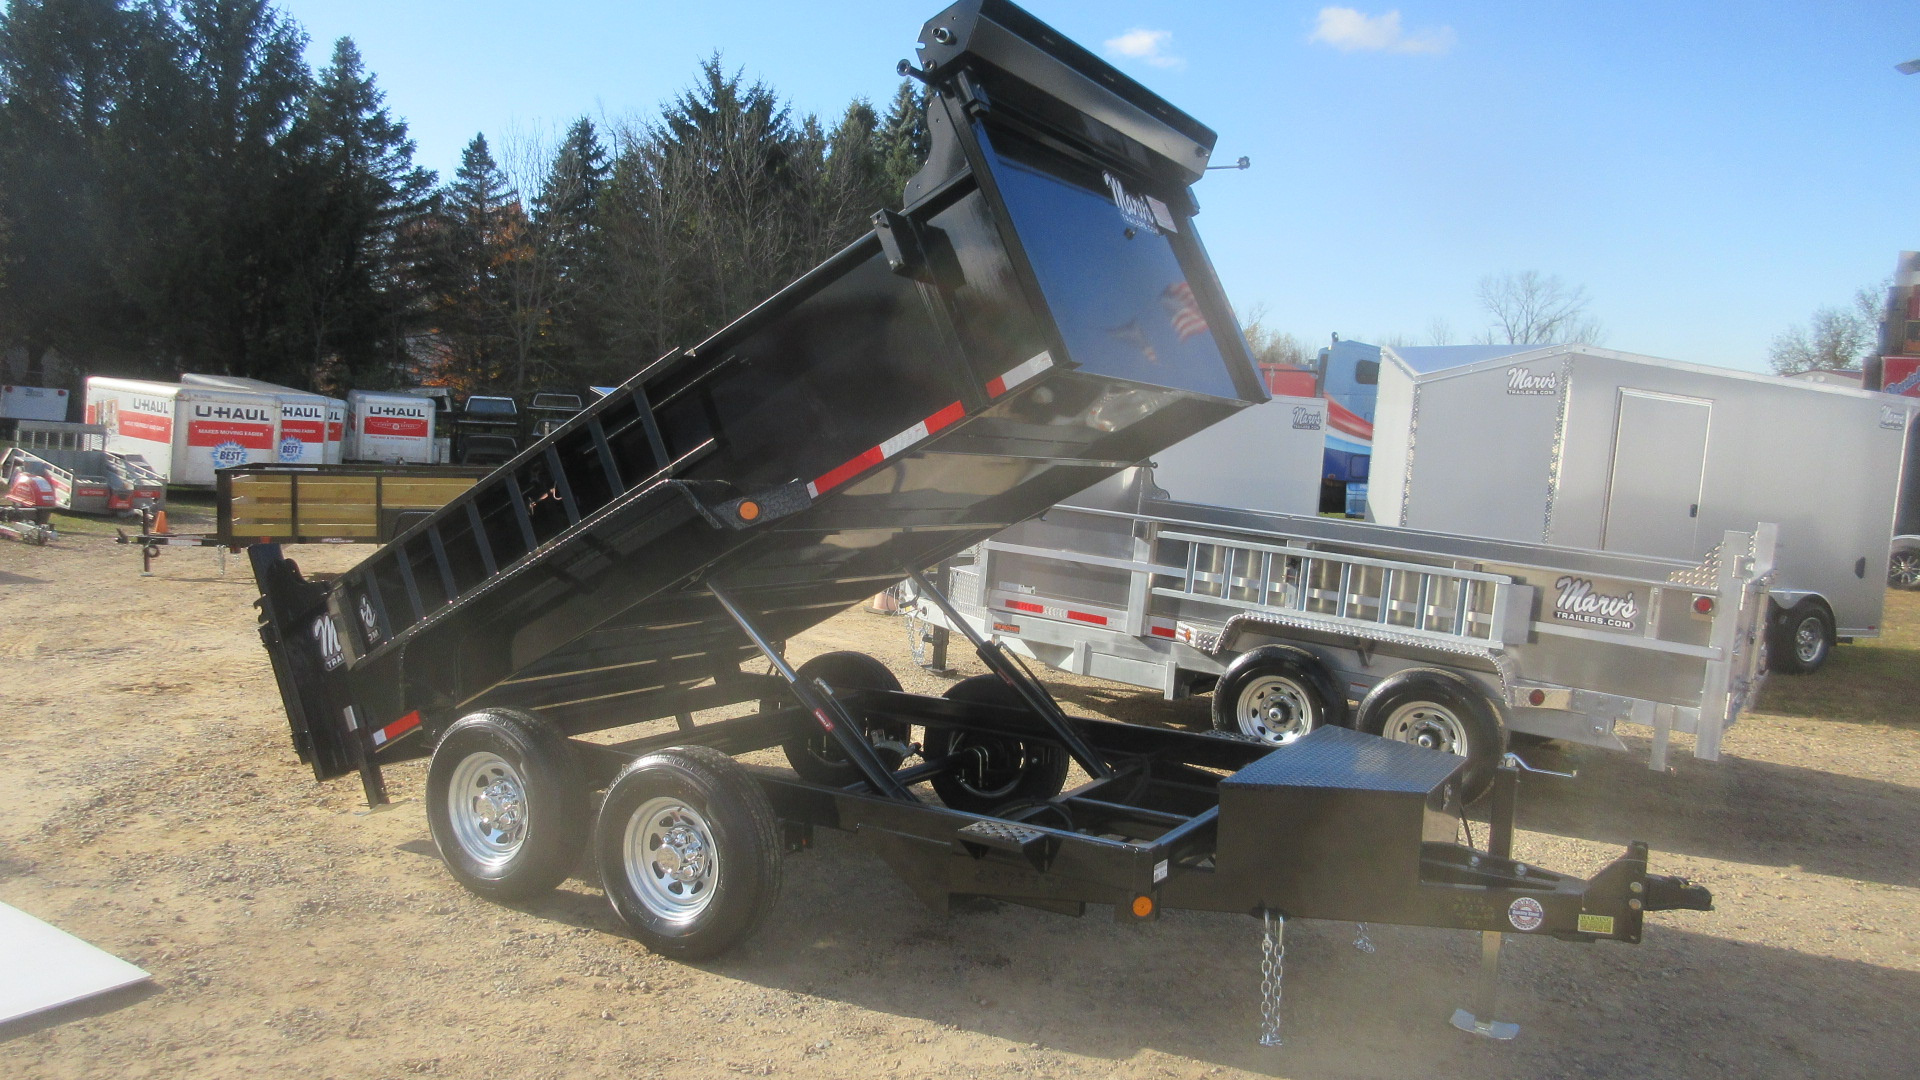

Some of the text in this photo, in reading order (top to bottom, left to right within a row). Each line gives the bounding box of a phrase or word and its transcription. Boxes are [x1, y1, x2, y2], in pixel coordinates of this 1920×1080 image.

[1507, 368, 1557, 389] Marv's
[133, 398, 169, 414] U-HAUL
[195, 404, 270, 421] U-HAUL
[281, 406, 322, 418] -HAUL
[369, 406, 425, 418] U-HAUL
[219, 450, 241, 461] BEST
[281, 445, 299, 454] BEST
[1556, 577, 1637, 619] Marv's
[1556, 611, 1631, 629] TRAILERS.COM
